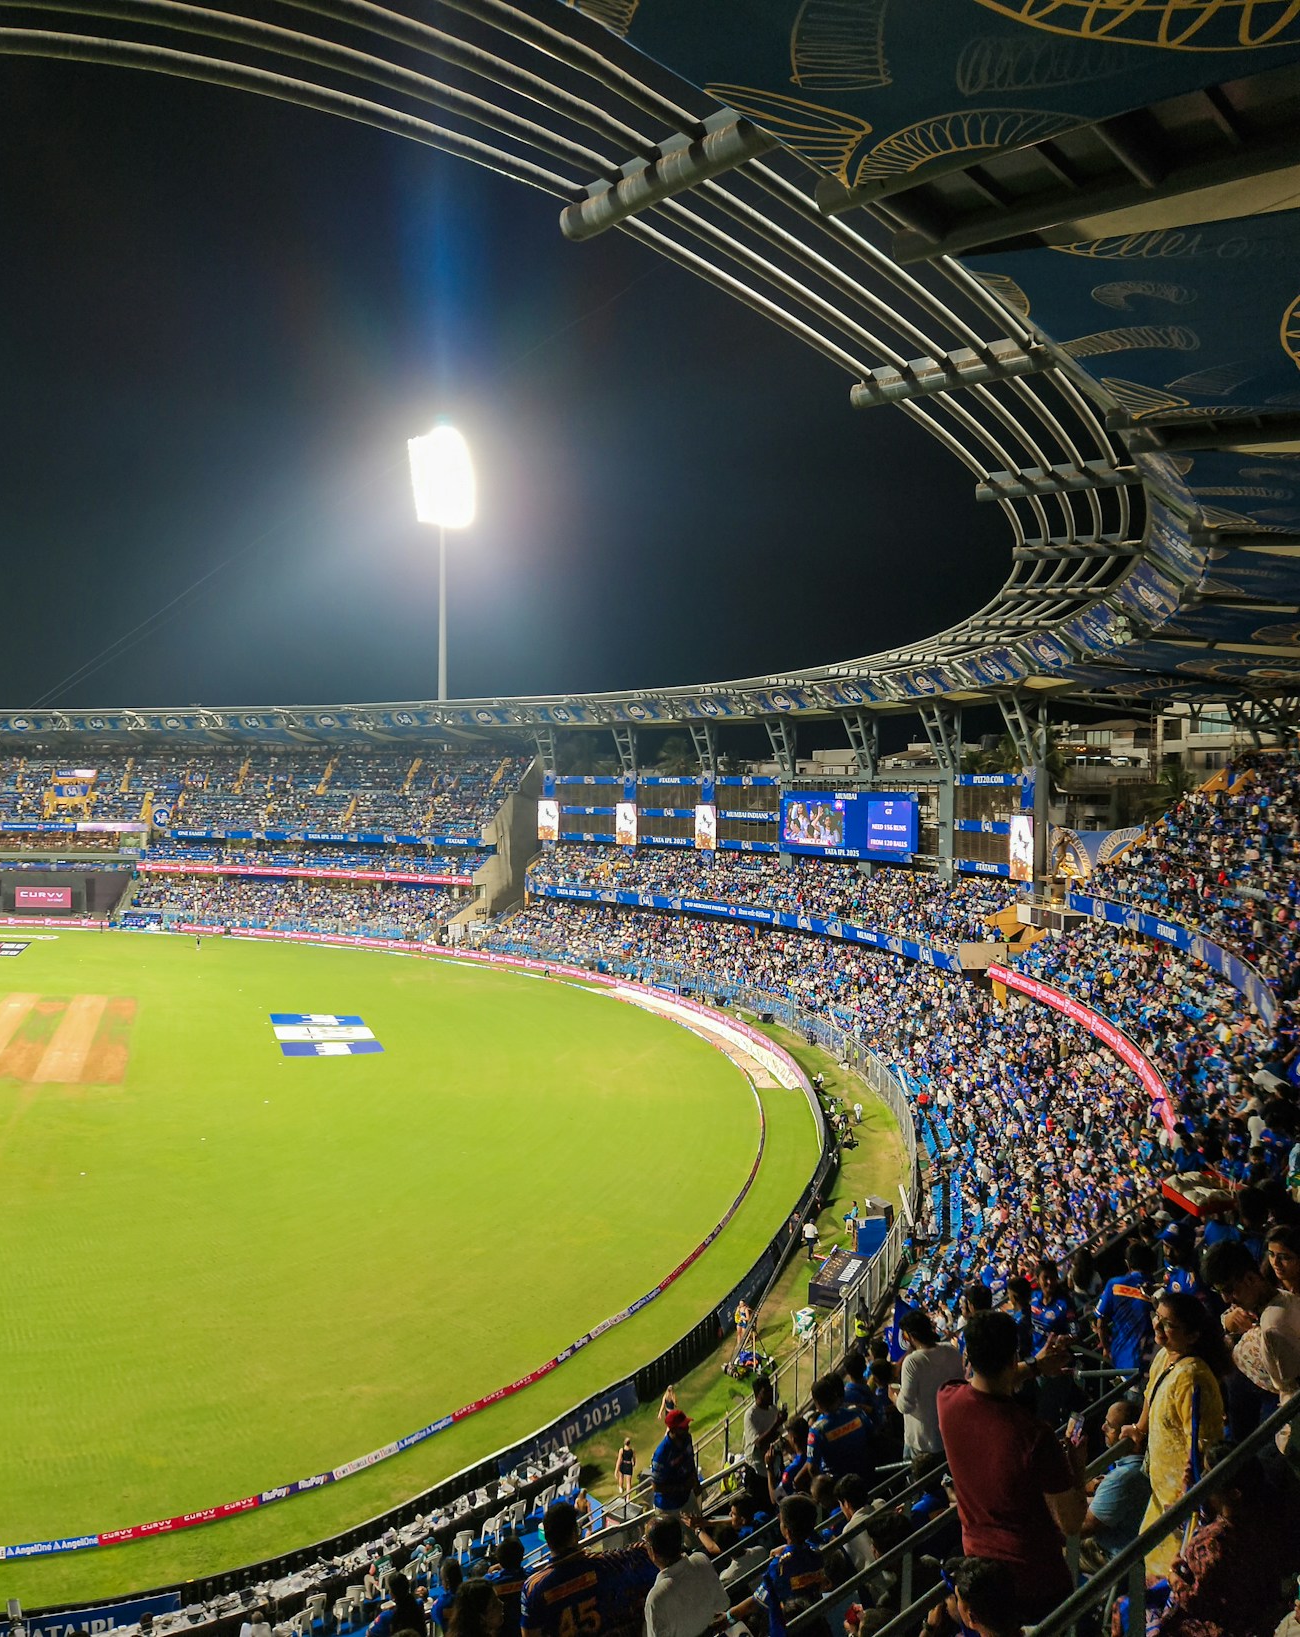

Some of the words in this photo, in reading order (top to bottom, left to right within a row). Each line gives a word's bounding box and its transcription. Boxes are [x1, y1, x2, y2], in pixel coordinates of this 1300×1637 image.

[972, 775, 1004, 784] IPLT20.COM
[835, 792, 857, 800] MUMBAI
[726, 810, 748, 820] MUMBAI
[748, 811, 769, 821] INDIANS
[871, 823, 883, 831] NEED
[893, 824, 906, 832] RUNS
[652, 836, 666, 844] TATA
[673, 837, 686, 845] 2025
[870, 838, 883, 846] FROM
[893, 839, 908, 848] BALLS
[824, 847, 838, 855] TATA
[846, 849, 859, 858] 2025
[975, 864, 999, 874] #TATAIPL
[556, 888, 568, 896] TATA
[568, 889, 578, 897] IPL
[578, 889, 592, 898] 2025
[856, 930, 877, 943] MUMBAI
[1156, 923, 1178, 943] #TATAIPL
[537, 1362, 554, 1374] CURVV
[512, 1375, 531, 1388] CURVV
[483, 1389, 504, 1403] CURVV
[455, 1403, 476, 1417] CURVV
[562, 1422, 583, 1447] IPL
[584, 1398, 621, 1432] 2025
[298, 1475, 325, 1490] RuPay
[262, 1486, 287, 1502] RuPay
[223, 1498, 255, 1511] CURVV
[183, 1509, 215, 1521] CURVV
[140, 1519, 172, 1531] CURVV
[102, 1528, 133, 1540] CURVV
[15, 1541, 52, 1556] AngelOne
[61, 1535, 99, 1550] AngelOne
